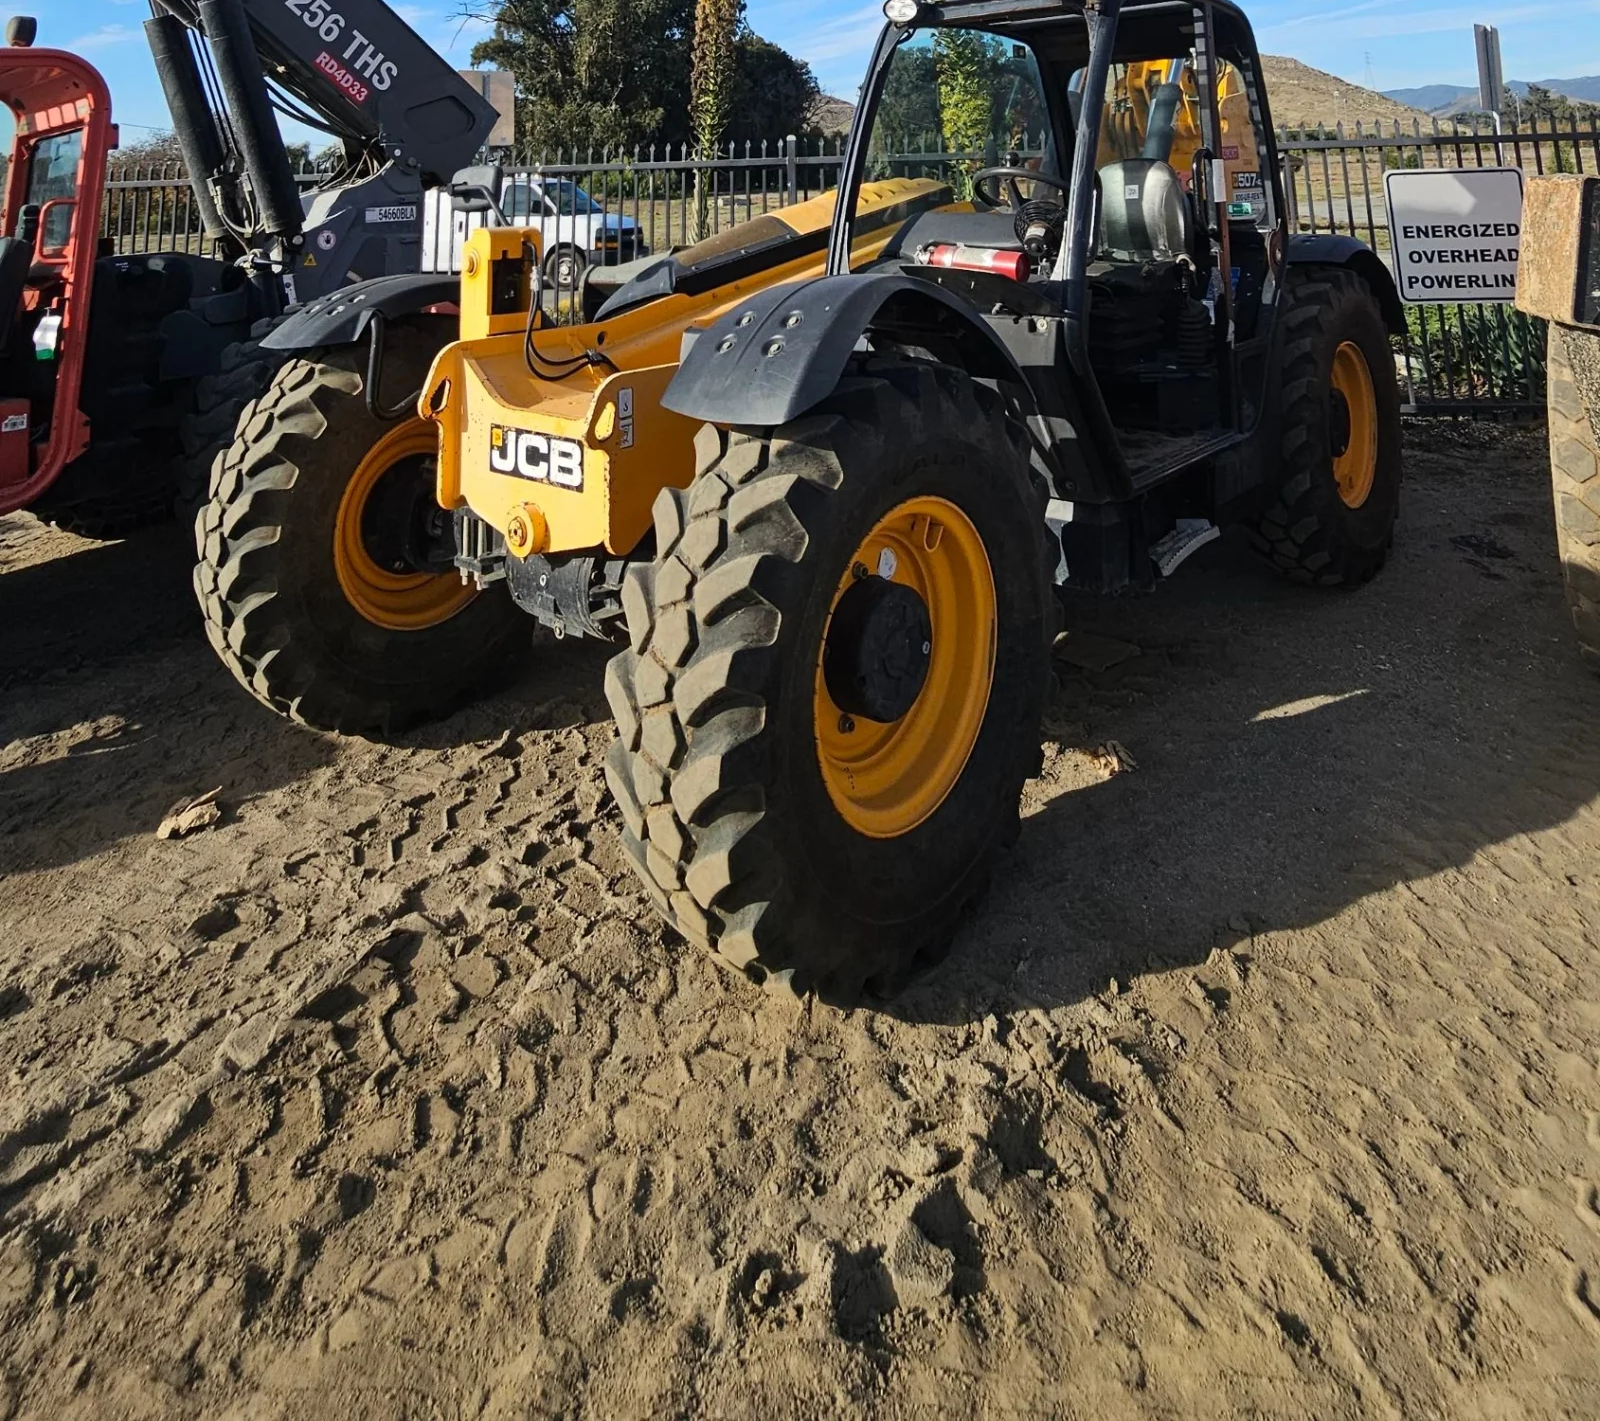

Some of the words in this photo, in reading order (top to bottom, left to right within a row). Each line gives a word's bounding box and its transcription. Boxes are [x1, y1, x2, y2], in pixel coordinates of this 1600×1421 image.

[315, 51, 368, 102] RD4D33
[342, 29, 398, 91] THS
[1402, 222, 1519, 239] ENERGIZED
[1408, 248, 1519, 264] OVERHEAD
[491, 429, 583, 488] JCB
